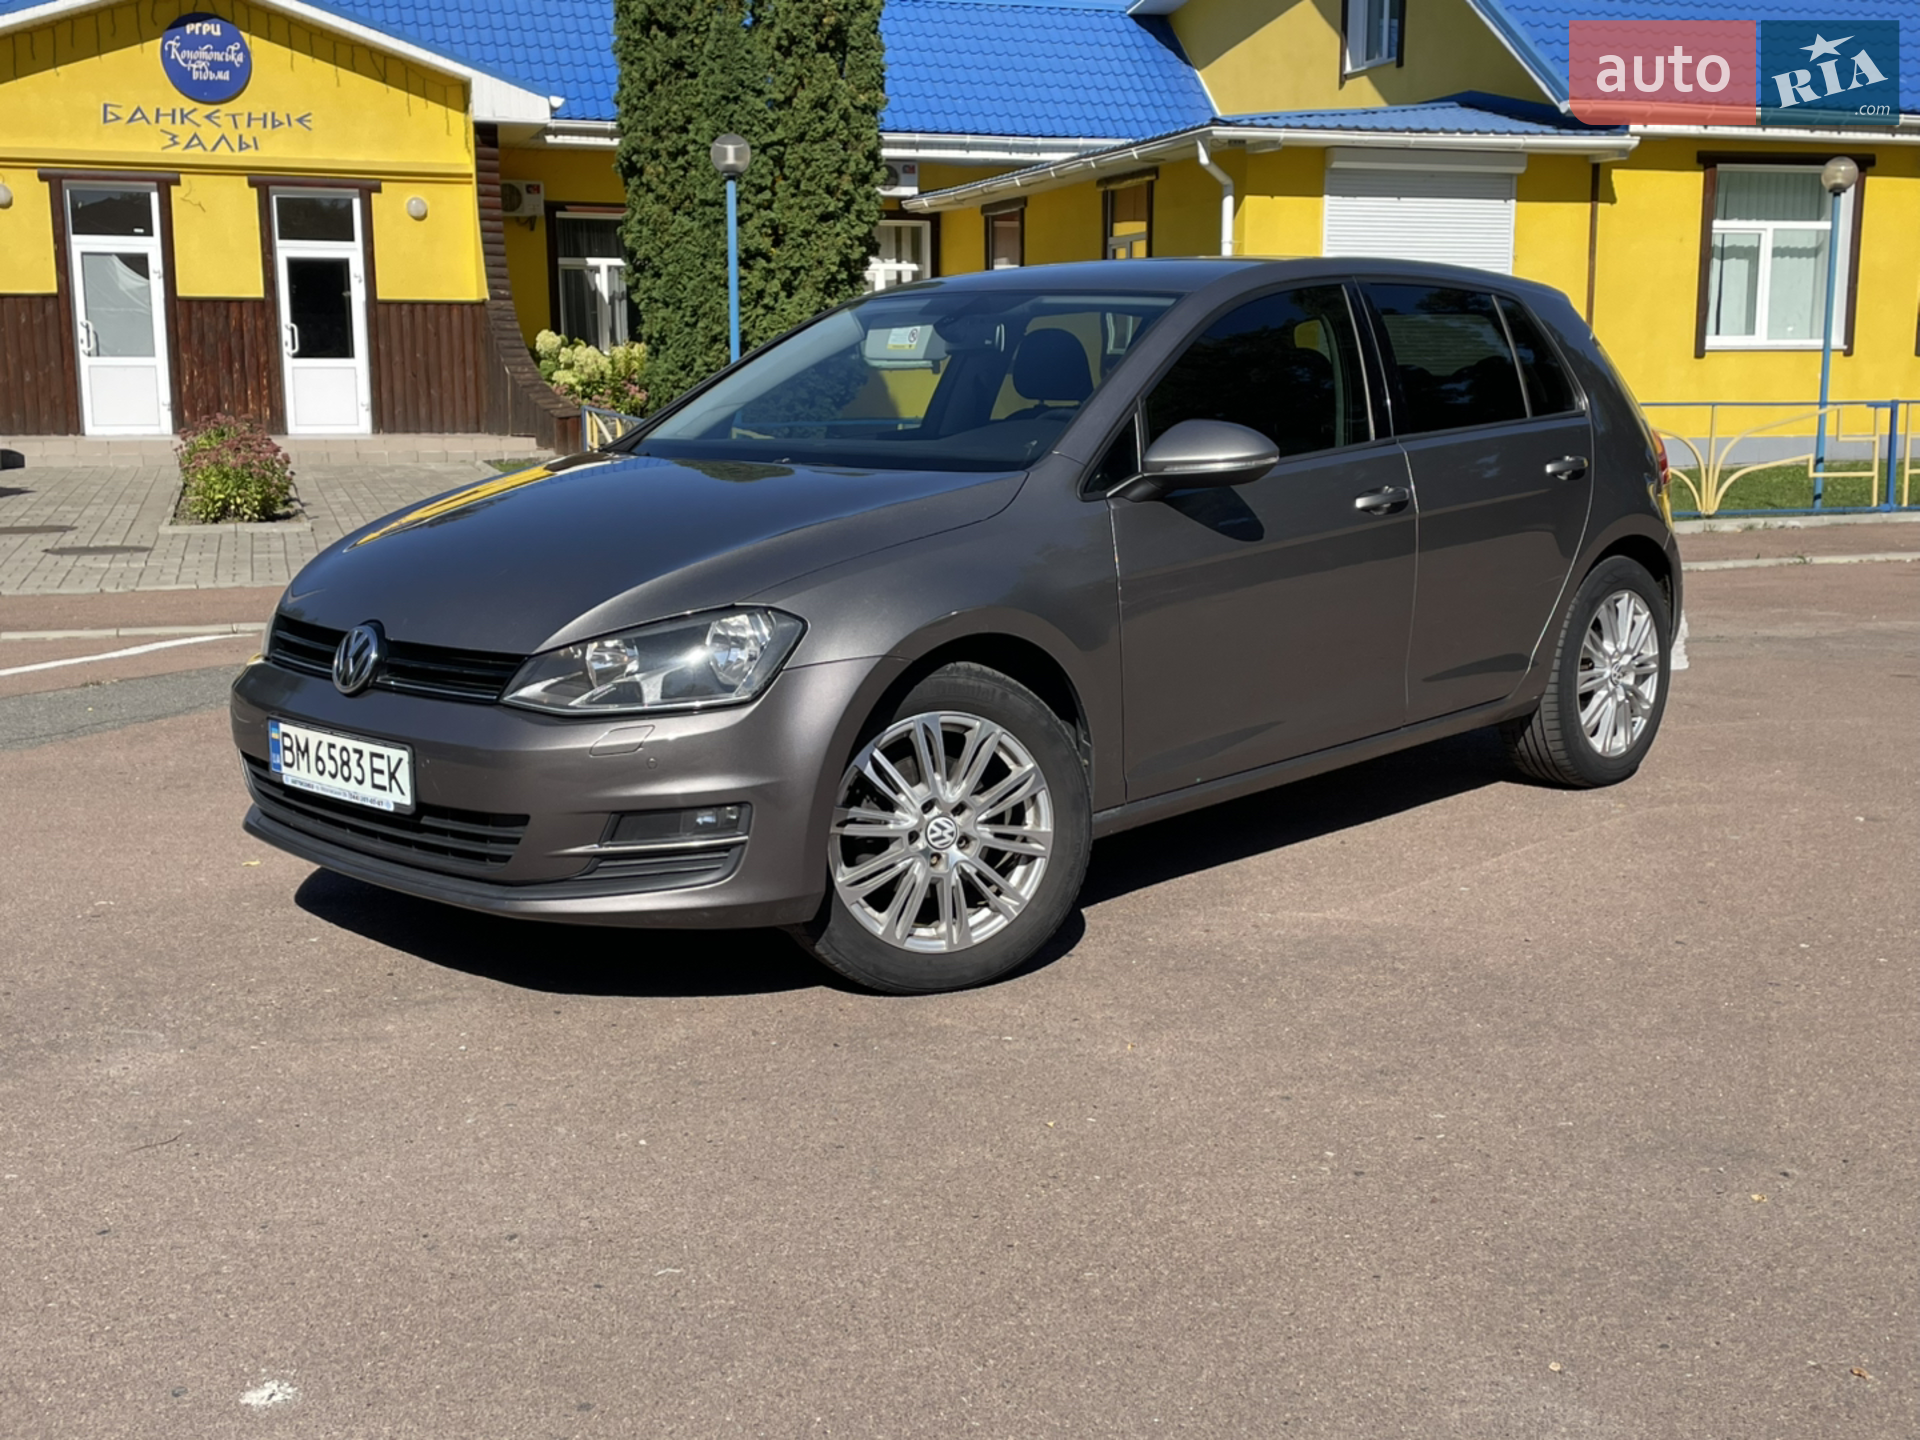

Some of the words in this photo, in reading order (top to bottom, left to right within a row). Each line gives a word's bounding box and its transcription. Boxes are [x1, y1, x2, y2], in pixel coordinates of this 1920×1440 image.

[165, 35, 244, 68] Конотопська
[102, 102, 313, 131] БАНКЕТНЫЕ
[159, 128, 260, 152] ЗАЛЫ
